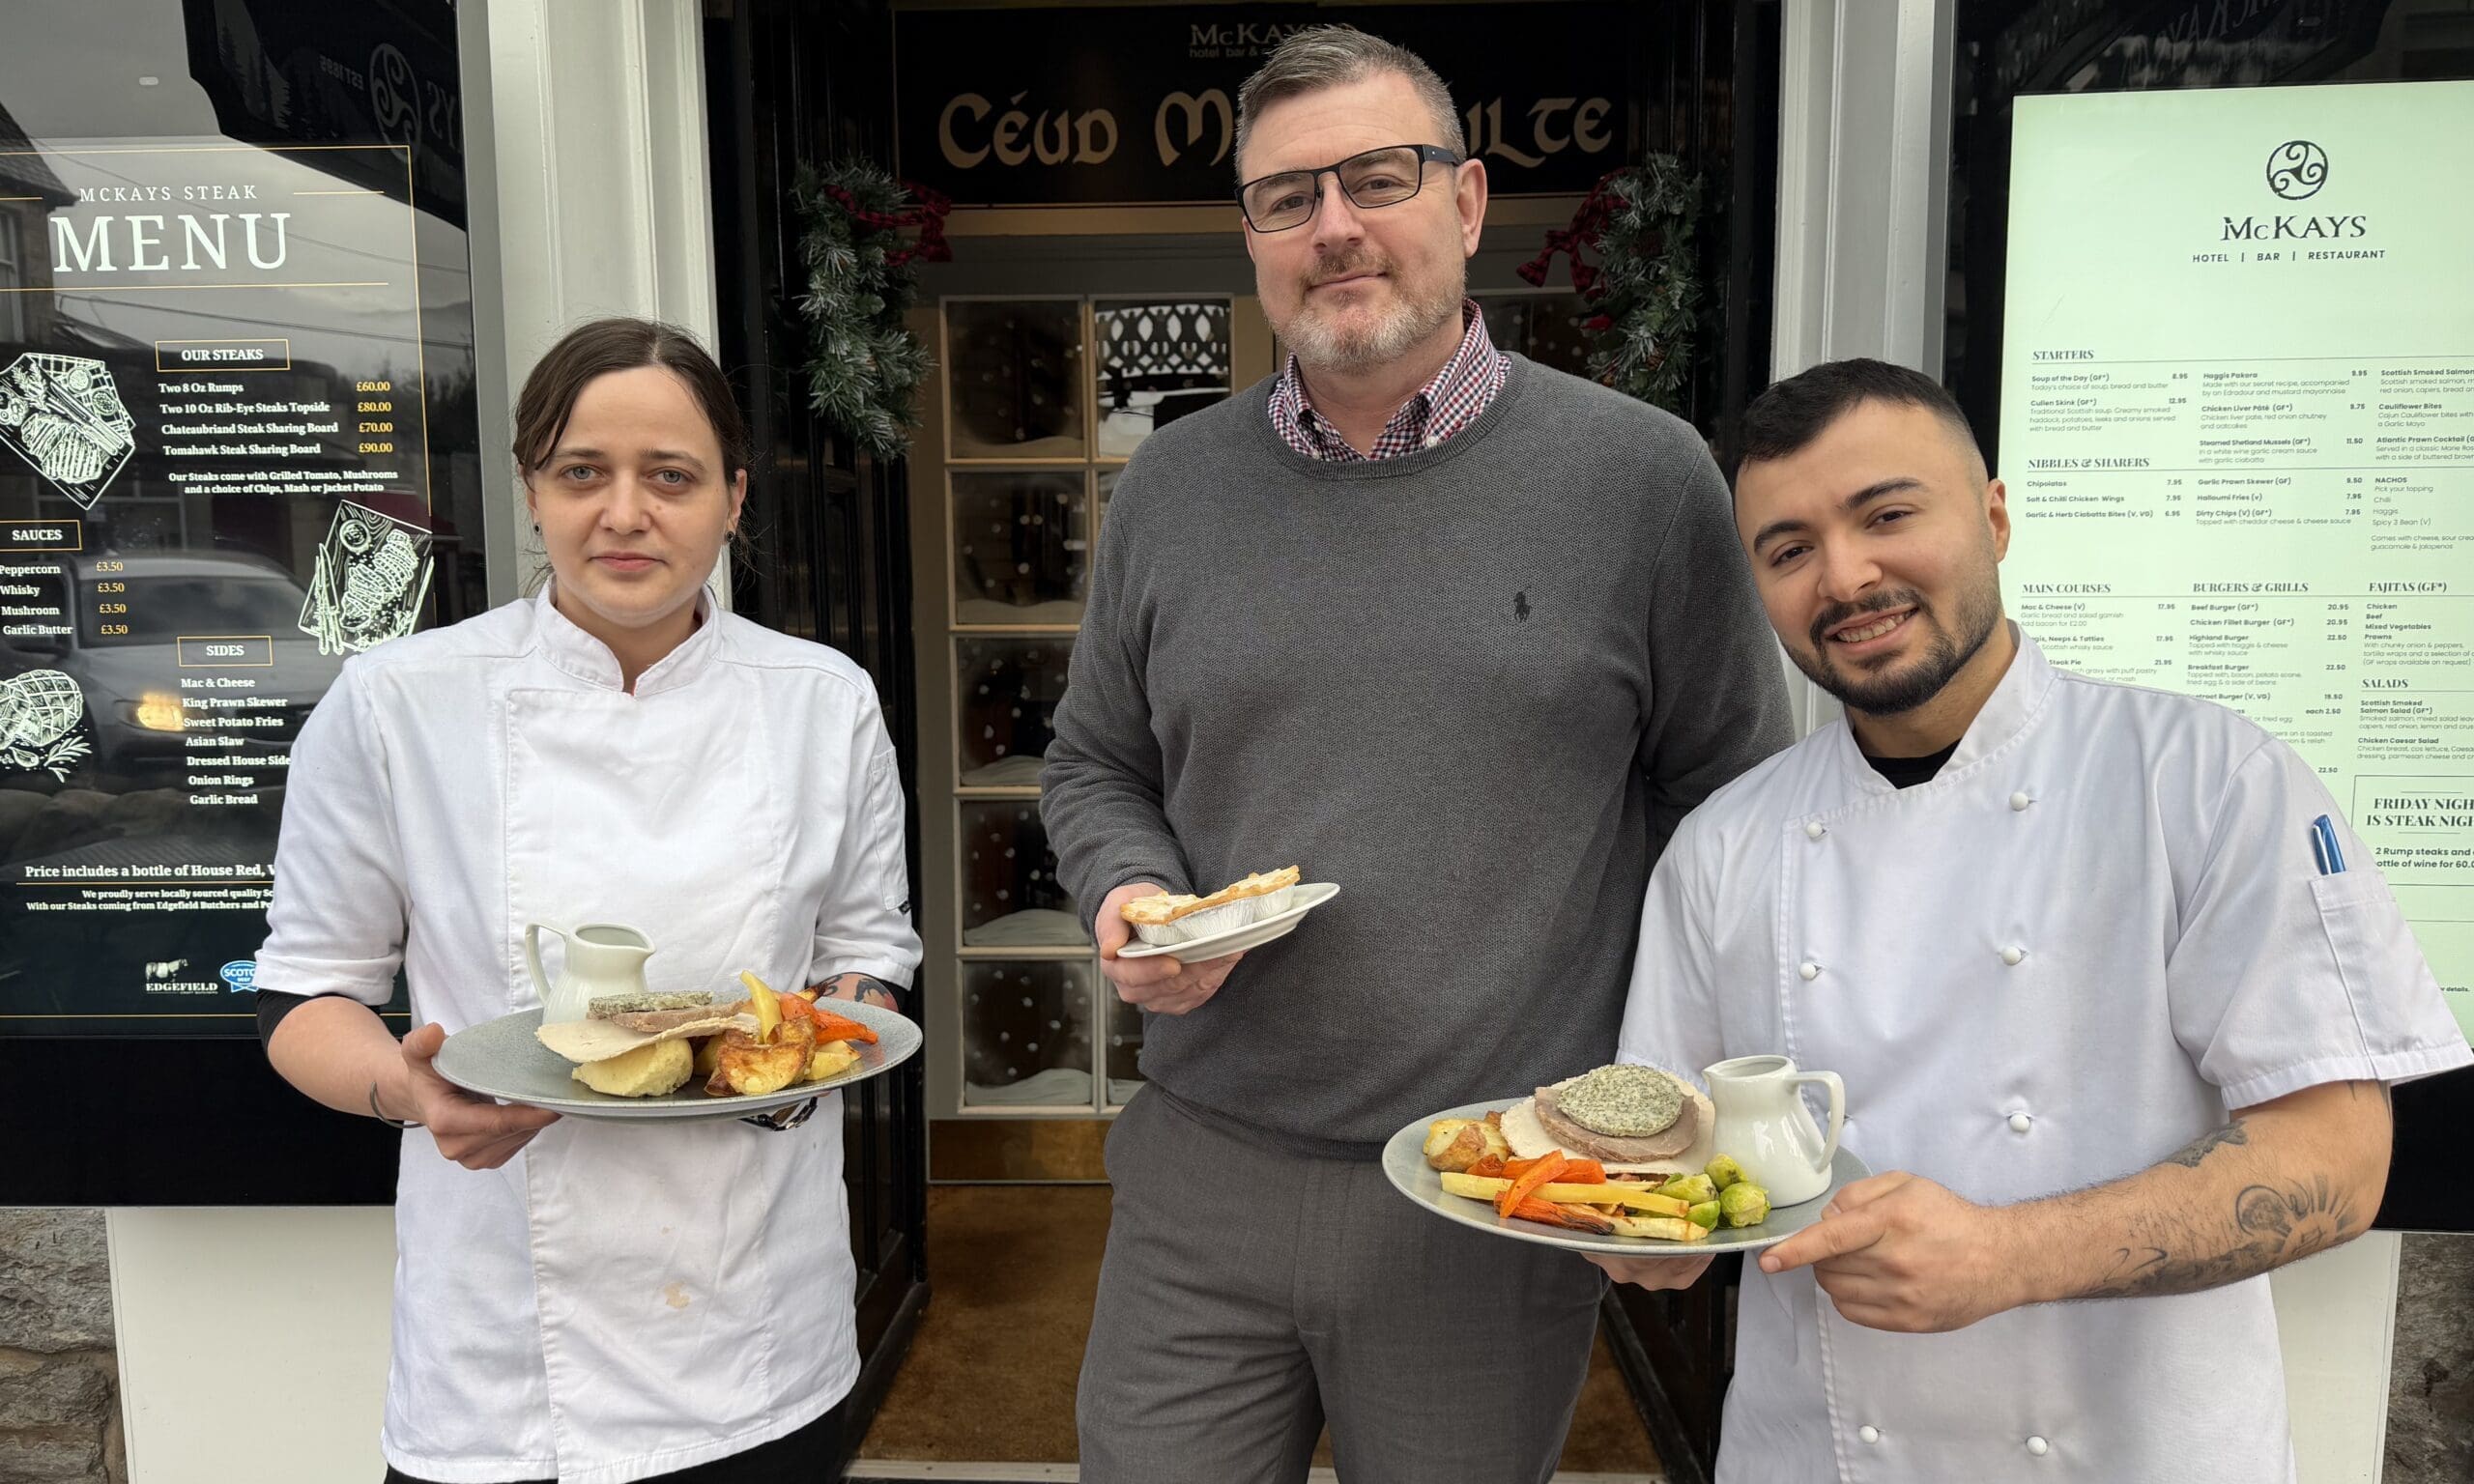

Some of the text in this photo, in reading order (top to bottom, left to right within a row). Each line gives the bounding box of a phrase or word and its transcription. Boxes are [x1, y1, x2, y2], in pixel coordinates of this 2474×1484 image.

[1190, 23, 1305, 45] McKAY
[1226, 48, 1246, 58] bar
[78, 185, 257, 202] MCKAYS STEAK
[2221, 214, 2367, 241] McKAYS
[50, 213, 291, 271] MENU
[2192, 249, 2385, 263] HOTEL BAR RESTAURANT
[182, 349, 264, 361] OUR STEAKS
[2032, 350, 2094, 360] STARTERS
[2073, 374, 2088, 383] Day
[158, 382, 390, 395] Two 8 Oz Rumps £60.00
[159, 402, 391, 415] Two 10 Oz Rib-Eye Steaks Topside £80.00
[161, 422, 393, 436] Chateaubriand Steak Sharing Board £70.00
[163, 442, 393, 457] Tomahawk Steak Sharing Board £90.00
[2028, 457, 2150, 469] NIBBLES & SHARERS
[169, 472, 187, 481] Our
[188, 472, 219, 481] Steaks
[246, 471, 268, 481] with
[270, 471, 302, 480] Grilled
[303, 471, 341, 481] Tomato,
[343, 471, 398, 480] Mushrooms
[185, 485, 202, 494] and
[212, 484, 241, 494] choice
[243, 484, 253, 494] of
[254, 484, 283, 495] Chips,
[285, 483, 309, 493] Mash
[324, 483, 352, 494] Jacket
[354, 483, 385, 493] Potato
[12, 529, 63, 541] SAUCES
[0, 561, 124, 578] Peppercorn £3.50
[0, 583, 125, 597] Whisky £3.50
[2022, 584, 2112, 593] MAIN COURSES
[2193, 583, 2309, 592] BURGERS & GRILLS
[2369, 583, 2415, 592] FAJITAS
[2, 604, 127, 616] Mushroom £3.50
[2210, 604, 2236, 613] Burger
[3, 624, 129, 636] Garlic Butter £3.50
[206, 645, 245, 657] SIDES
[181, 678, 255, 688] Mac & Cheese
[2362, 679, 2408, 689] SALADS
[183, 698, 288, 709] King Prawn Skewer
[184, 717, 284, 728] Sweet Potato Fries
[186, 737, 245, 747] Asian Slaw
[187, 756, 291, 766] Dressed House Side
[188, 776, 254, 787] Onion Rings
[189, 794, 258, 805] Garlic Bread
[2373, 798, 2474, 810] FRIDAY NIGH
[2367, 814, 2381, 826] IS
[2384, 815, 2436, 827] STEAK
[2383, 847, 2413, 858] Rump
[2413, 860, 2438, 869] wine
[2439, 860, 2454, 869] for
[25, 867, 60, 878] Price
[62, 866, 119, 877] includes
[121, 868, 129, 877] a
[131, 865, 172, 876] bottle
[174, 865, 190, 876] of
[191, 865, 233, 876] House
[236, 864, 266, 877] Red,
[82, 890, 97, 899] We
[98, 890, 133, 899] proudly
[161, 889, 191, 899] locally
[192, 889, 228, 898] sourced
[230, 889, 262, 899] quality
[27, 902, 48, 911] With
[68, 901, 97, 910] Steaks
[98, 901, 131, 912] coming
[132, 901, 156, 910] from
[157, 901, 199, 911] Edgefield
[200, 901, 241, 910] Butchers
[146, 983, 218, 991] EDGEFIELD
